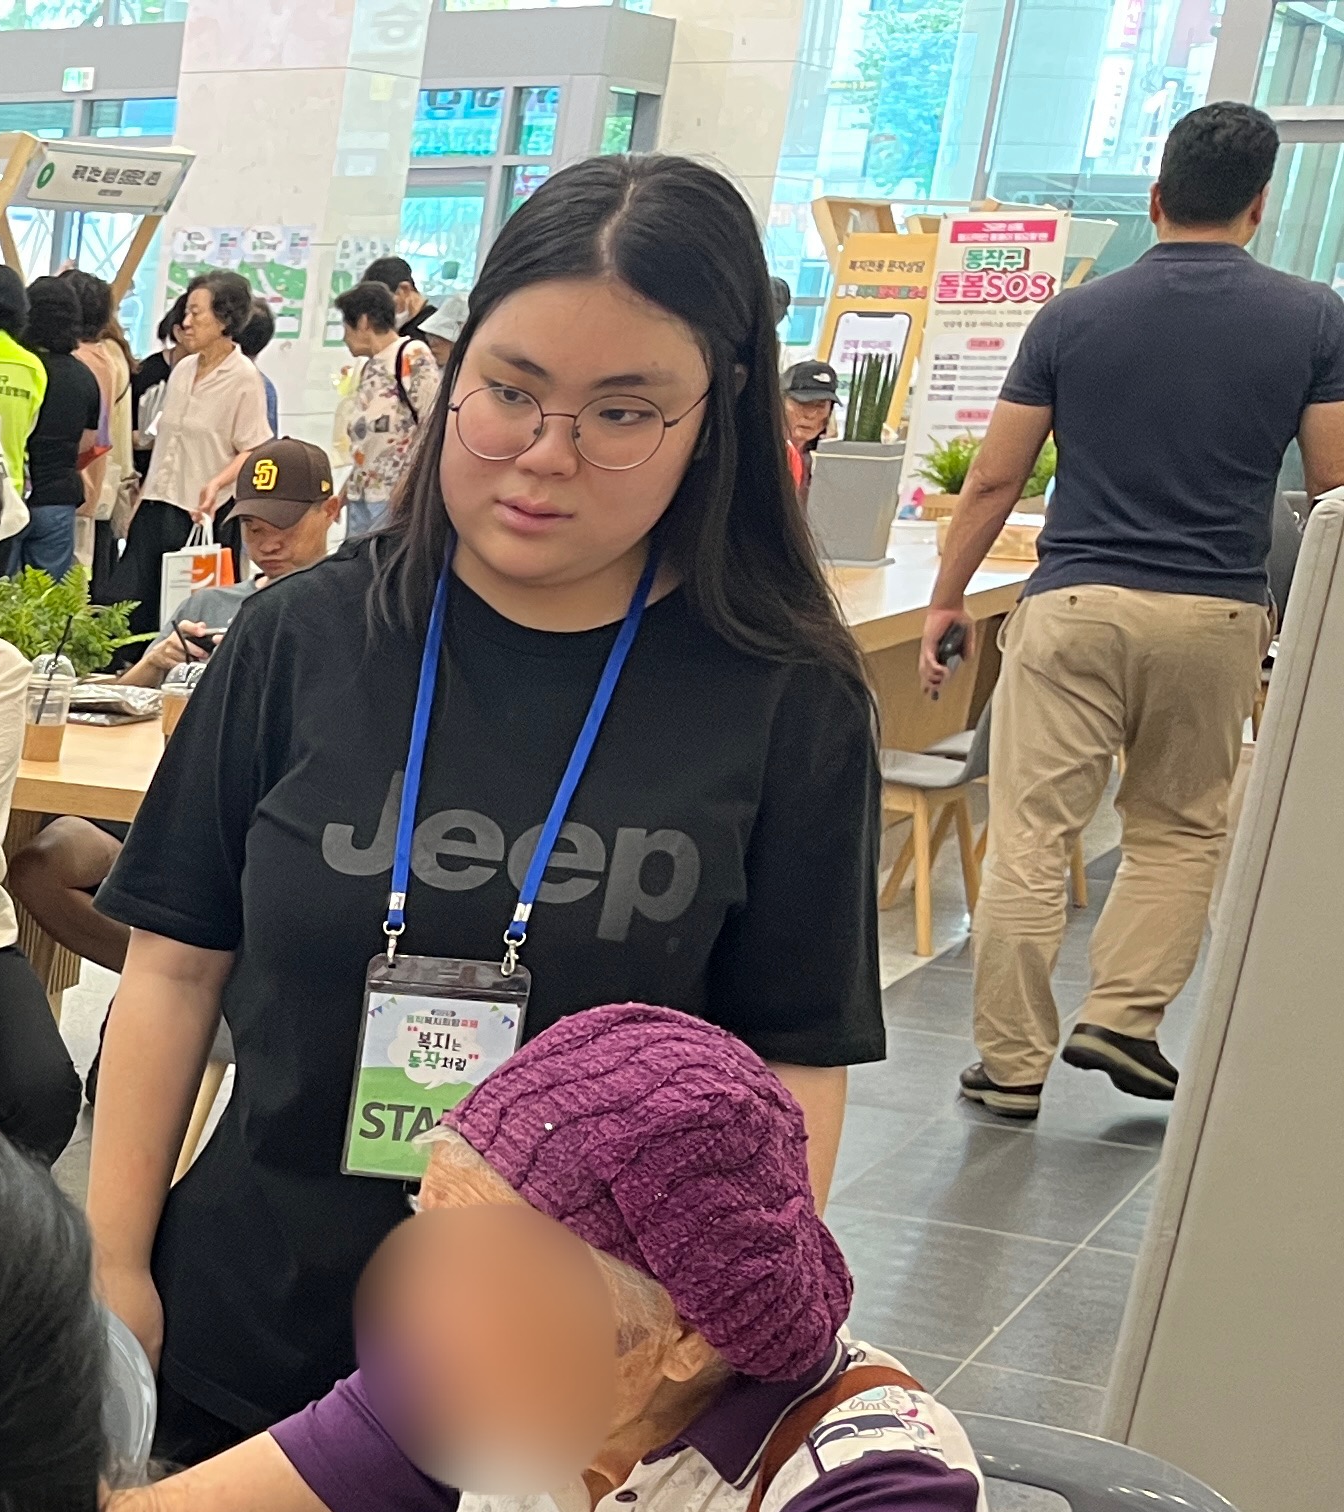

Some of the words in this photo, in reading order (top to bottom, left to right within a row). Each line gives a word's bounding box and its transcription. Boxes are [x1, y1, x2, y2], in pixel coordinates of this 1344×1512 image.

[965, 249, 1022, 269] 동작구
[321, 770, 701, 942] Jeep
[417, 1030, 462, 1052] 복지는
[408, 1050, 467, 1072] 동작처럼
[359, 1101, 450, 1143] STA
